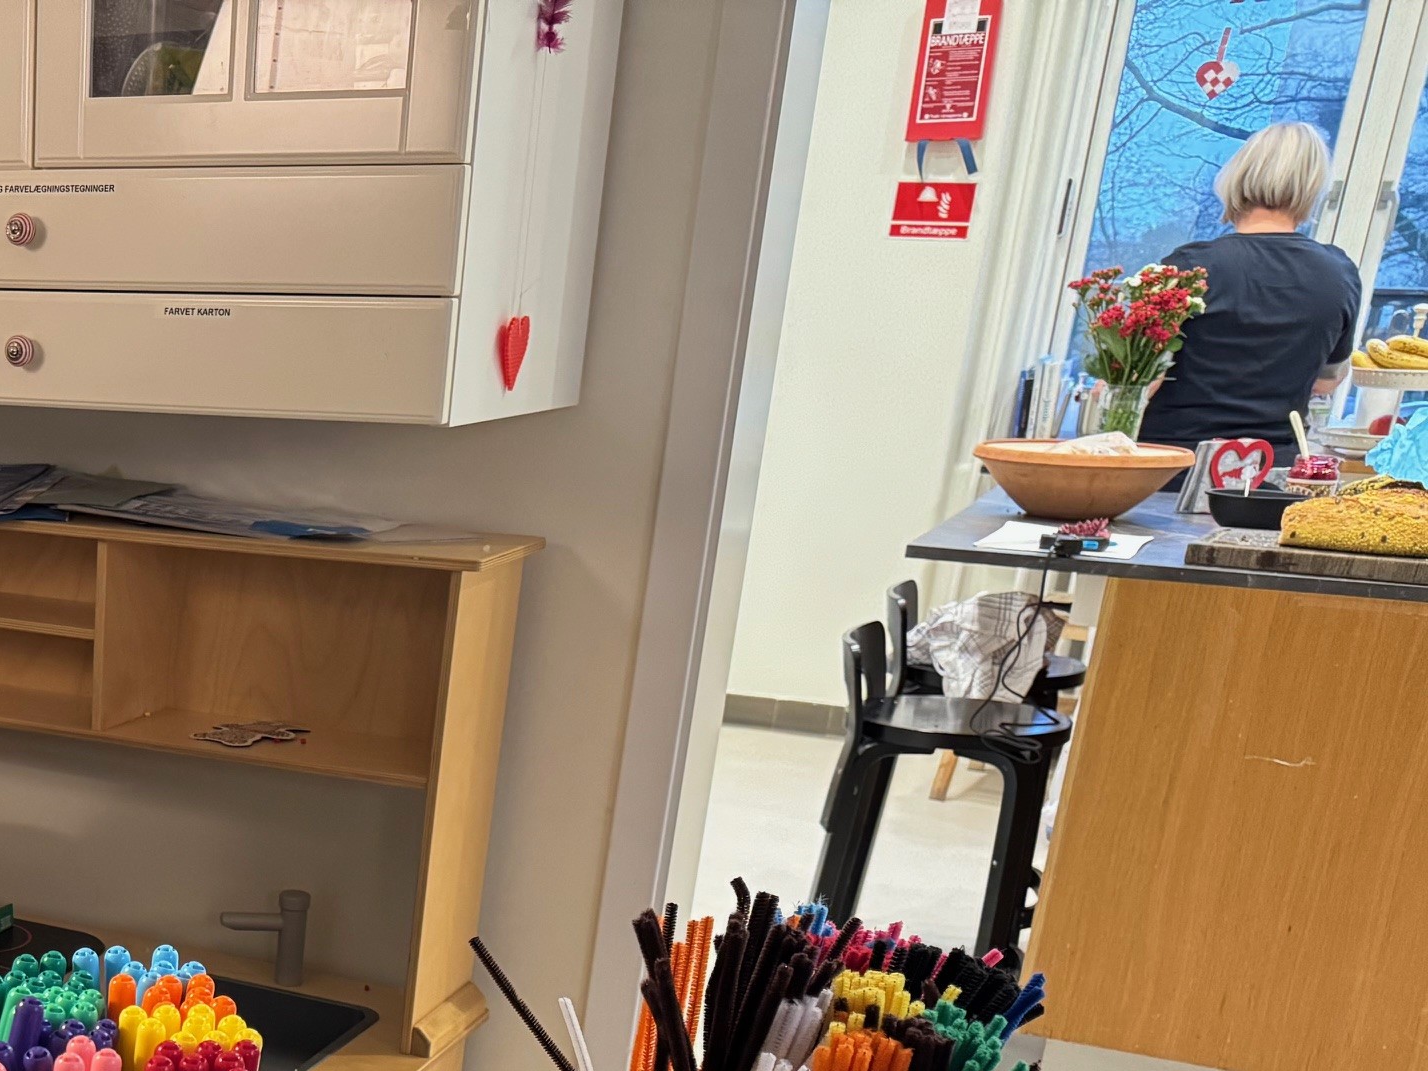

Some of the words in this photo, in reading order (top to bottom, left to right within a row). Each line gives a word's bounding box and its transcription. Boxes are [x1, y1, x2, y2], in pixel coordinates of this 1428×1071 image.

[930, 33, 985, 47] BRANDTÆPPE
[4, 184, 115, 193] FARVELÆGNINGSTEGNINGER
[899, 225, 958, 237] Brandtæppe
[164, 307, 195, 316] FARVET
[196, 308, 231, 316] KARTON
